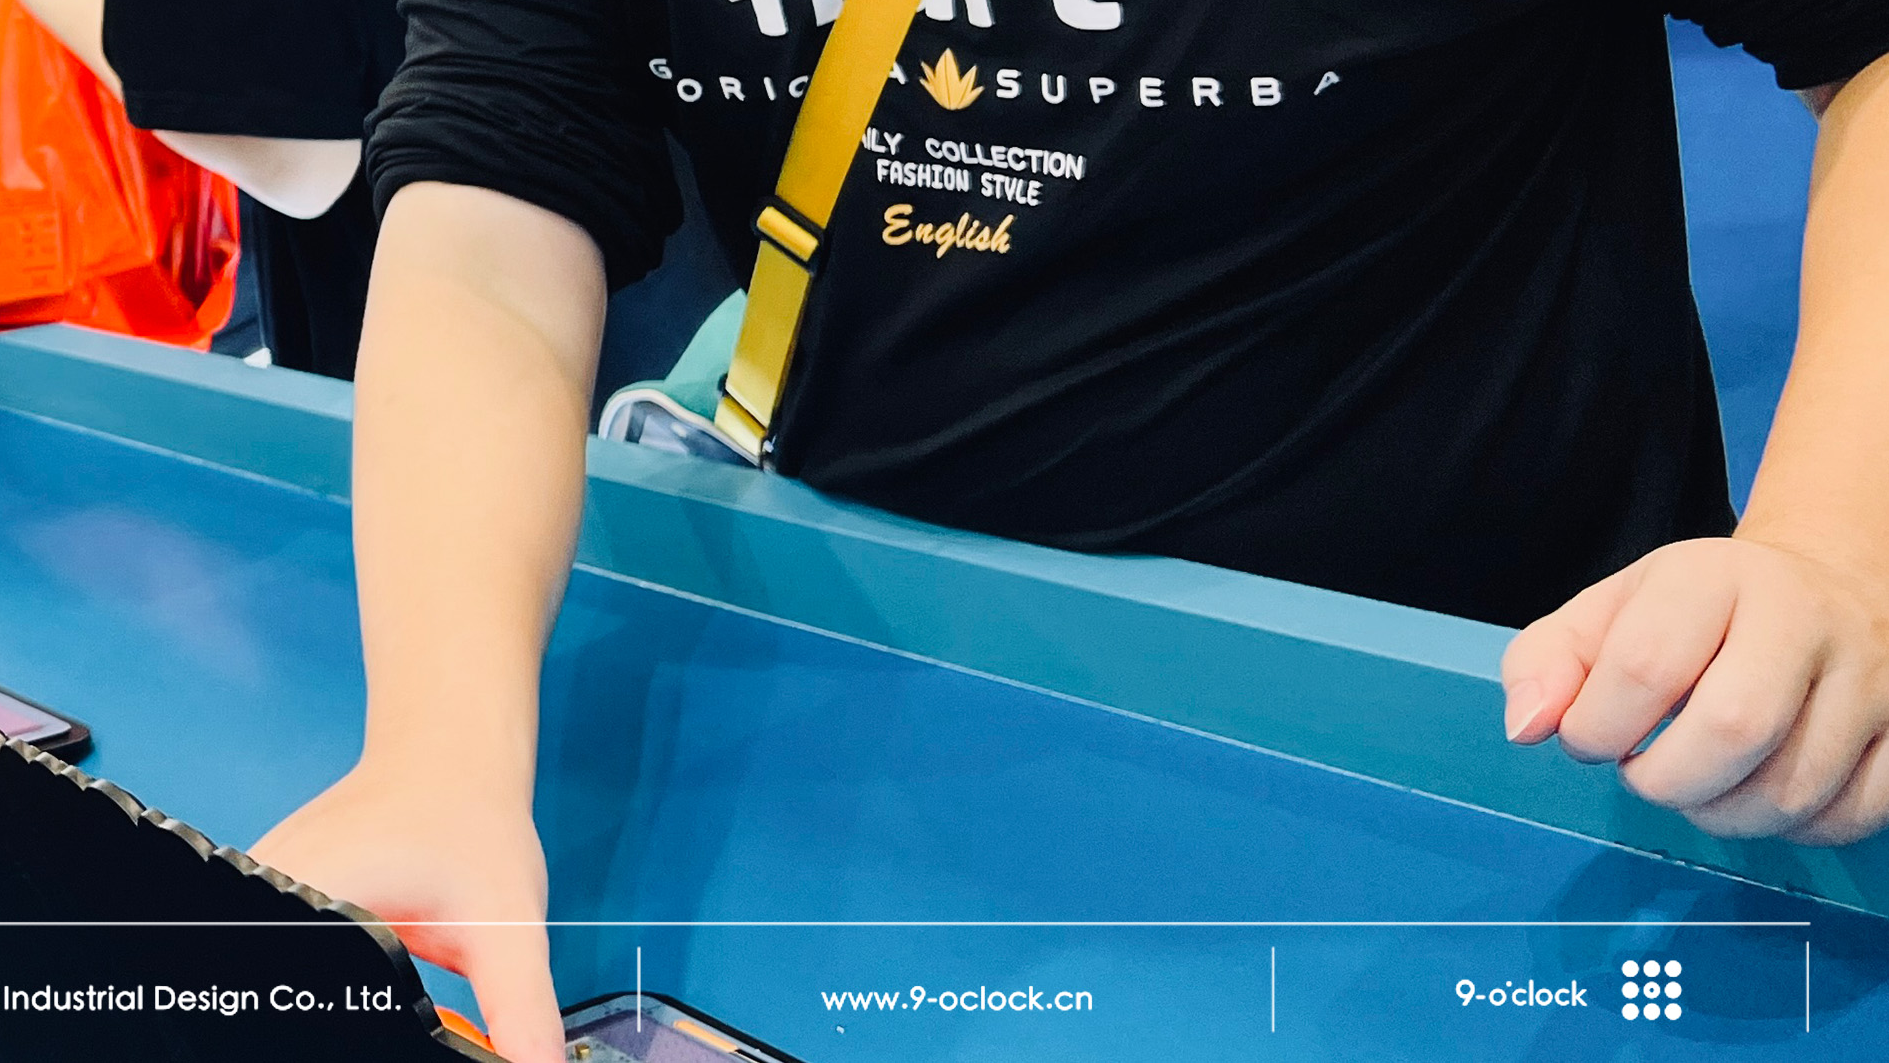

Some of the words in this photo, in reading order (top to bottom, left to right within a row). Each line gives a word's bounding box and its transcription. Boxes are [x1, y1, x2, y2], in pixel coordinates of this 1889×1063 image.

[995, 68, 1341, 108] SUPERBA
[876, 159, 971, 193] FASHION
[925, 137, 1087, 181] COLLECTION
[881, 203, 1015, 259] English
